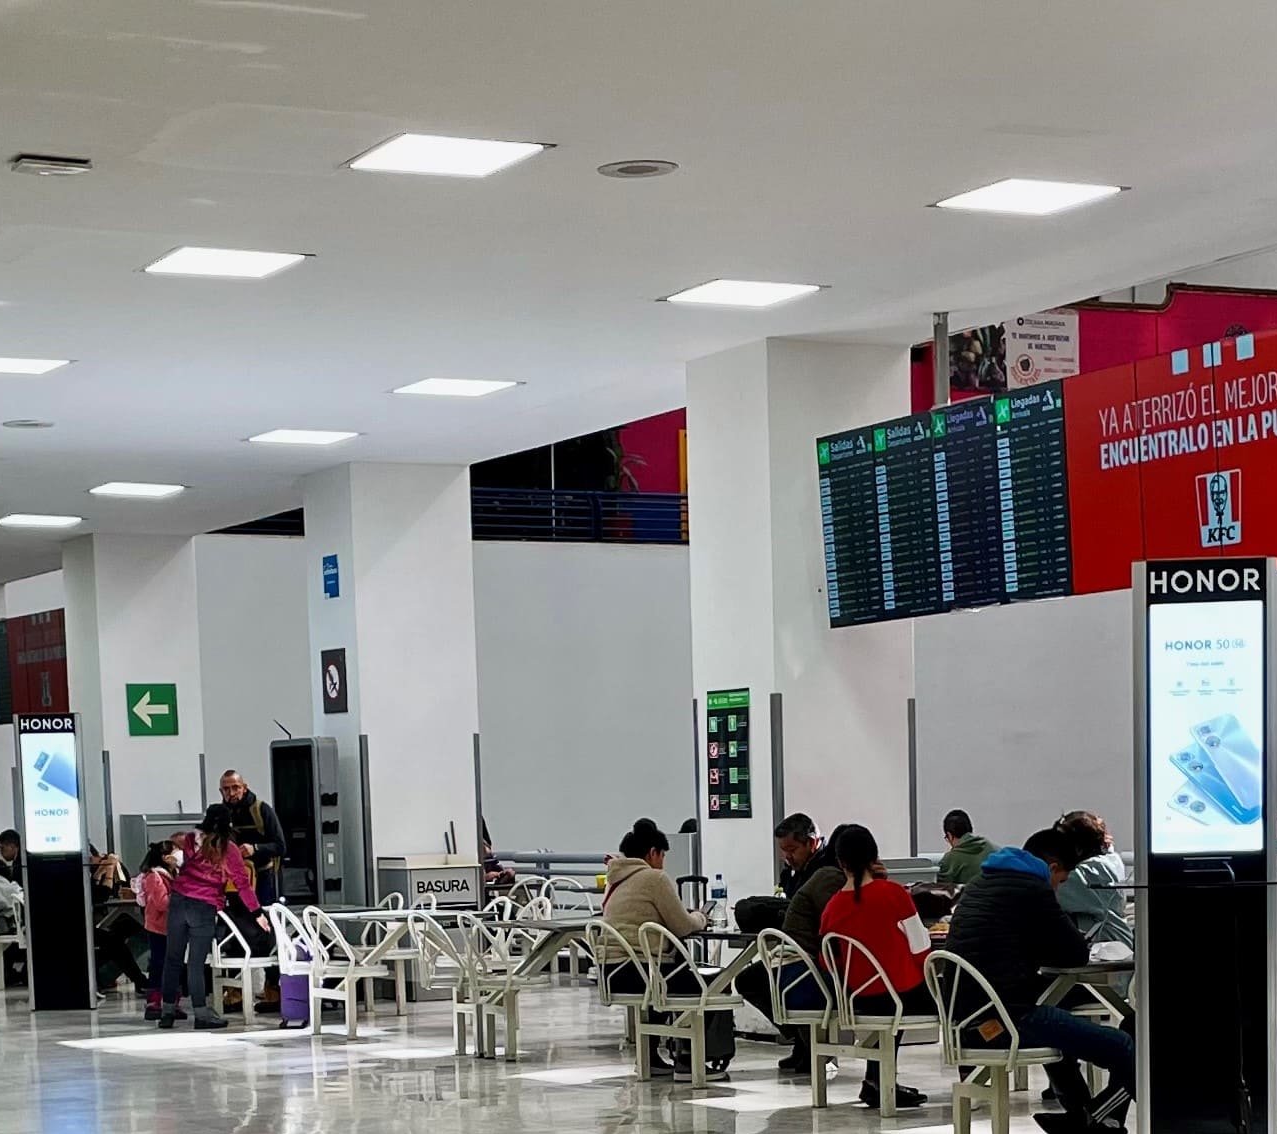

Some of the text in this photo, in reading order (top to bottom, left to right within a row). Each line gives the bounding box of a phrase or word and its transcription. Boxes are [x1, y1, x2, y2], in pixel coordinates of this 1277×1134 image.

[1010, 393, 1040, 410] Llegadas
[1098, 406, 1120, 438] YA
[1122, 382, 1198, 433] ATERRIZÓ
[1201, 383, 1221, 416] EL
[1100, 422, 1209, 470] ENCUÉNTRALO
[1212, 417, 1234, 448] EN
[1238, 412, 1259, 444] LA
[1207, 526, 1236, 543] KFC
[1149, 568, 1261, 594] HONOR
[1165, 640, 1212, 651] HONOR
[1216, 639, 1230, 650] 50
[20, 718, 73, 731] HONOR
[34, 808, 69, 817] HONOR
[416, 879, 470, 893] BASURA
